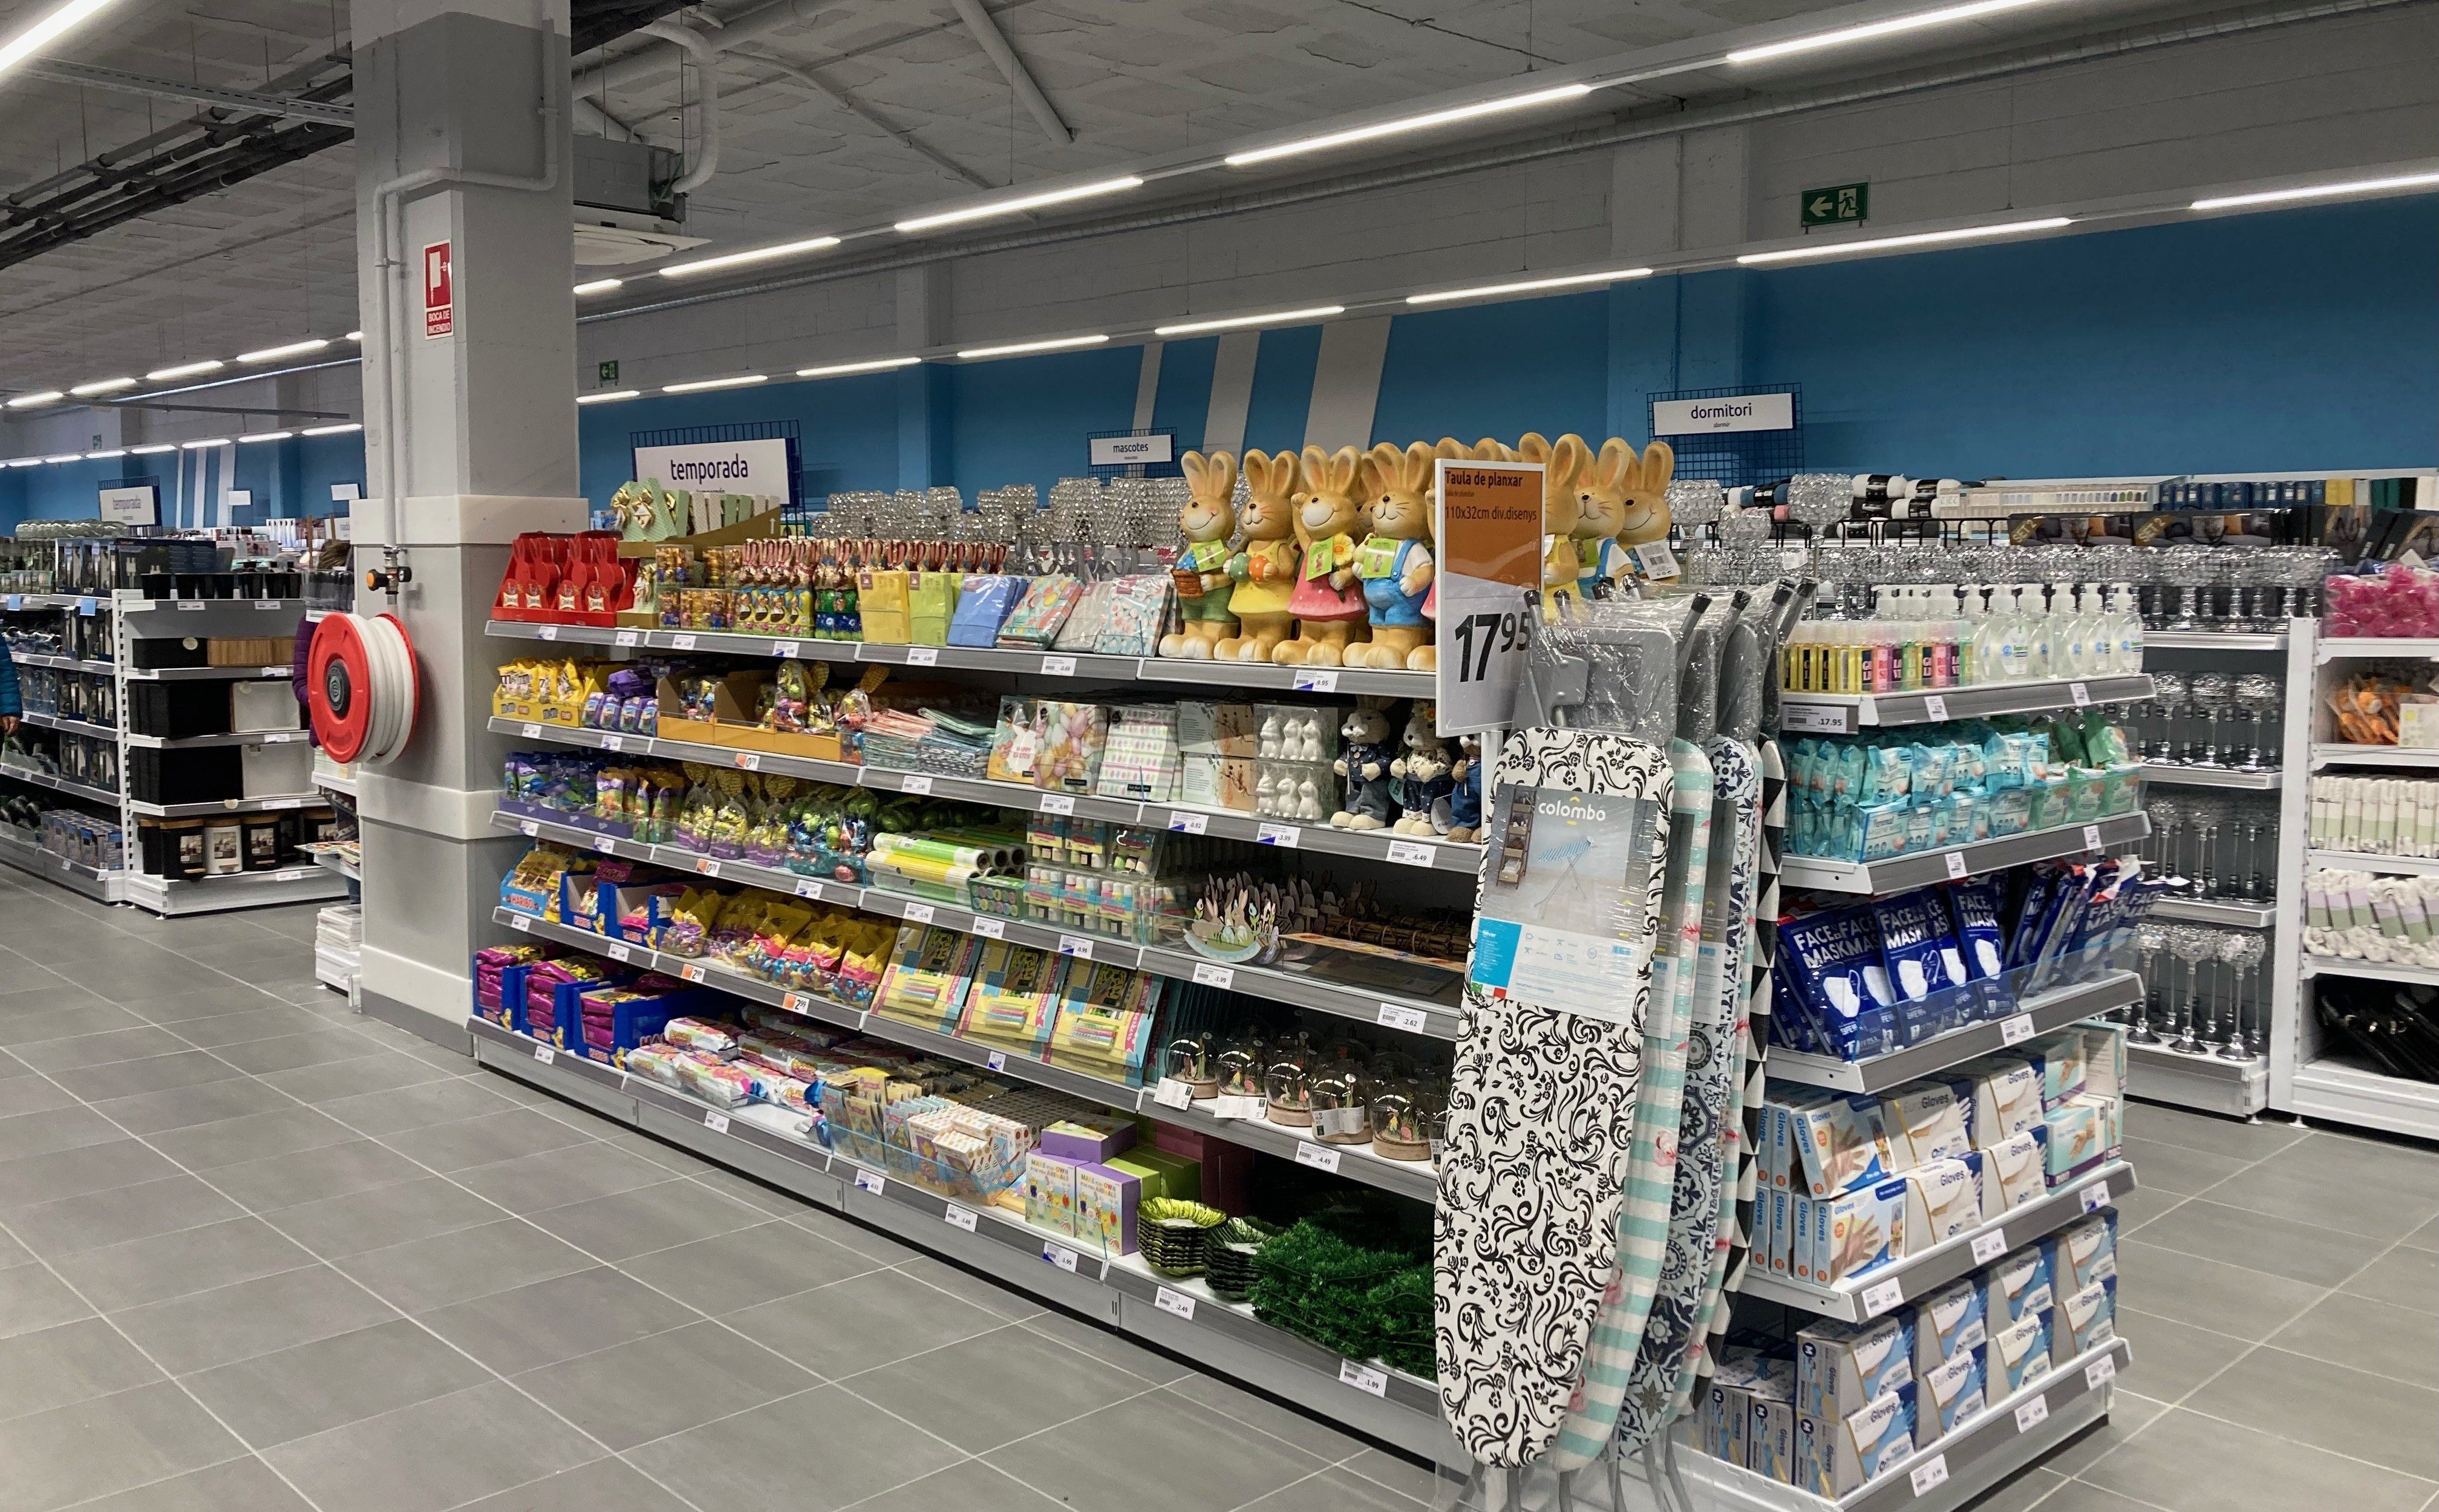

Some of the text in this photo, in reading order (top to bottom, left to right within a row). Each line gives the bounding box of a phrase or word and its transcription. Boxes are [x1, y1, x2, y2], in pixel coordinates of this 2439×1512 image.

[428, 310, 450, 322] BOCA DE
[428, 322, 451, 334] INCENDIO
[1691, 402, 1752, 419] dormitori
[1113, 442, 1149, 453] mascotes
[670, 453, 749, 484] temporada
[1445, 471, 1523, 489] Taula de planxar
[1445, 506, 1537, 523] 110x32cm div.disenys
[2012, 524, 2030, 543] SET
[2138, 524, 2157, 543] SET
[1820, 718, 1843, 726] 17.95
[1538, 800, 1606, 821] colombo
[1958, 895, 1993, 911] FACE
[1879, 908, 1915, 930] FACE
[1963, 911, 1998, 928] MASK
[1793, 925, 1835, 951] FACE
[1802, 942, 1848, 968] MASK
[1759, 1107, 1768, 1142] Gloves
[1777, 1112, 1786, 1147] Gloves
[1797, 1118, 1811, 1155] Gloves
[1775, 1196, 1784, 1231] Gloves
[1834, 1202, 1855, 1215] Gloves
[1818, 1206, 1827, 1242] Gloves
[1828, 1367, 1837, 1396] Gloves
